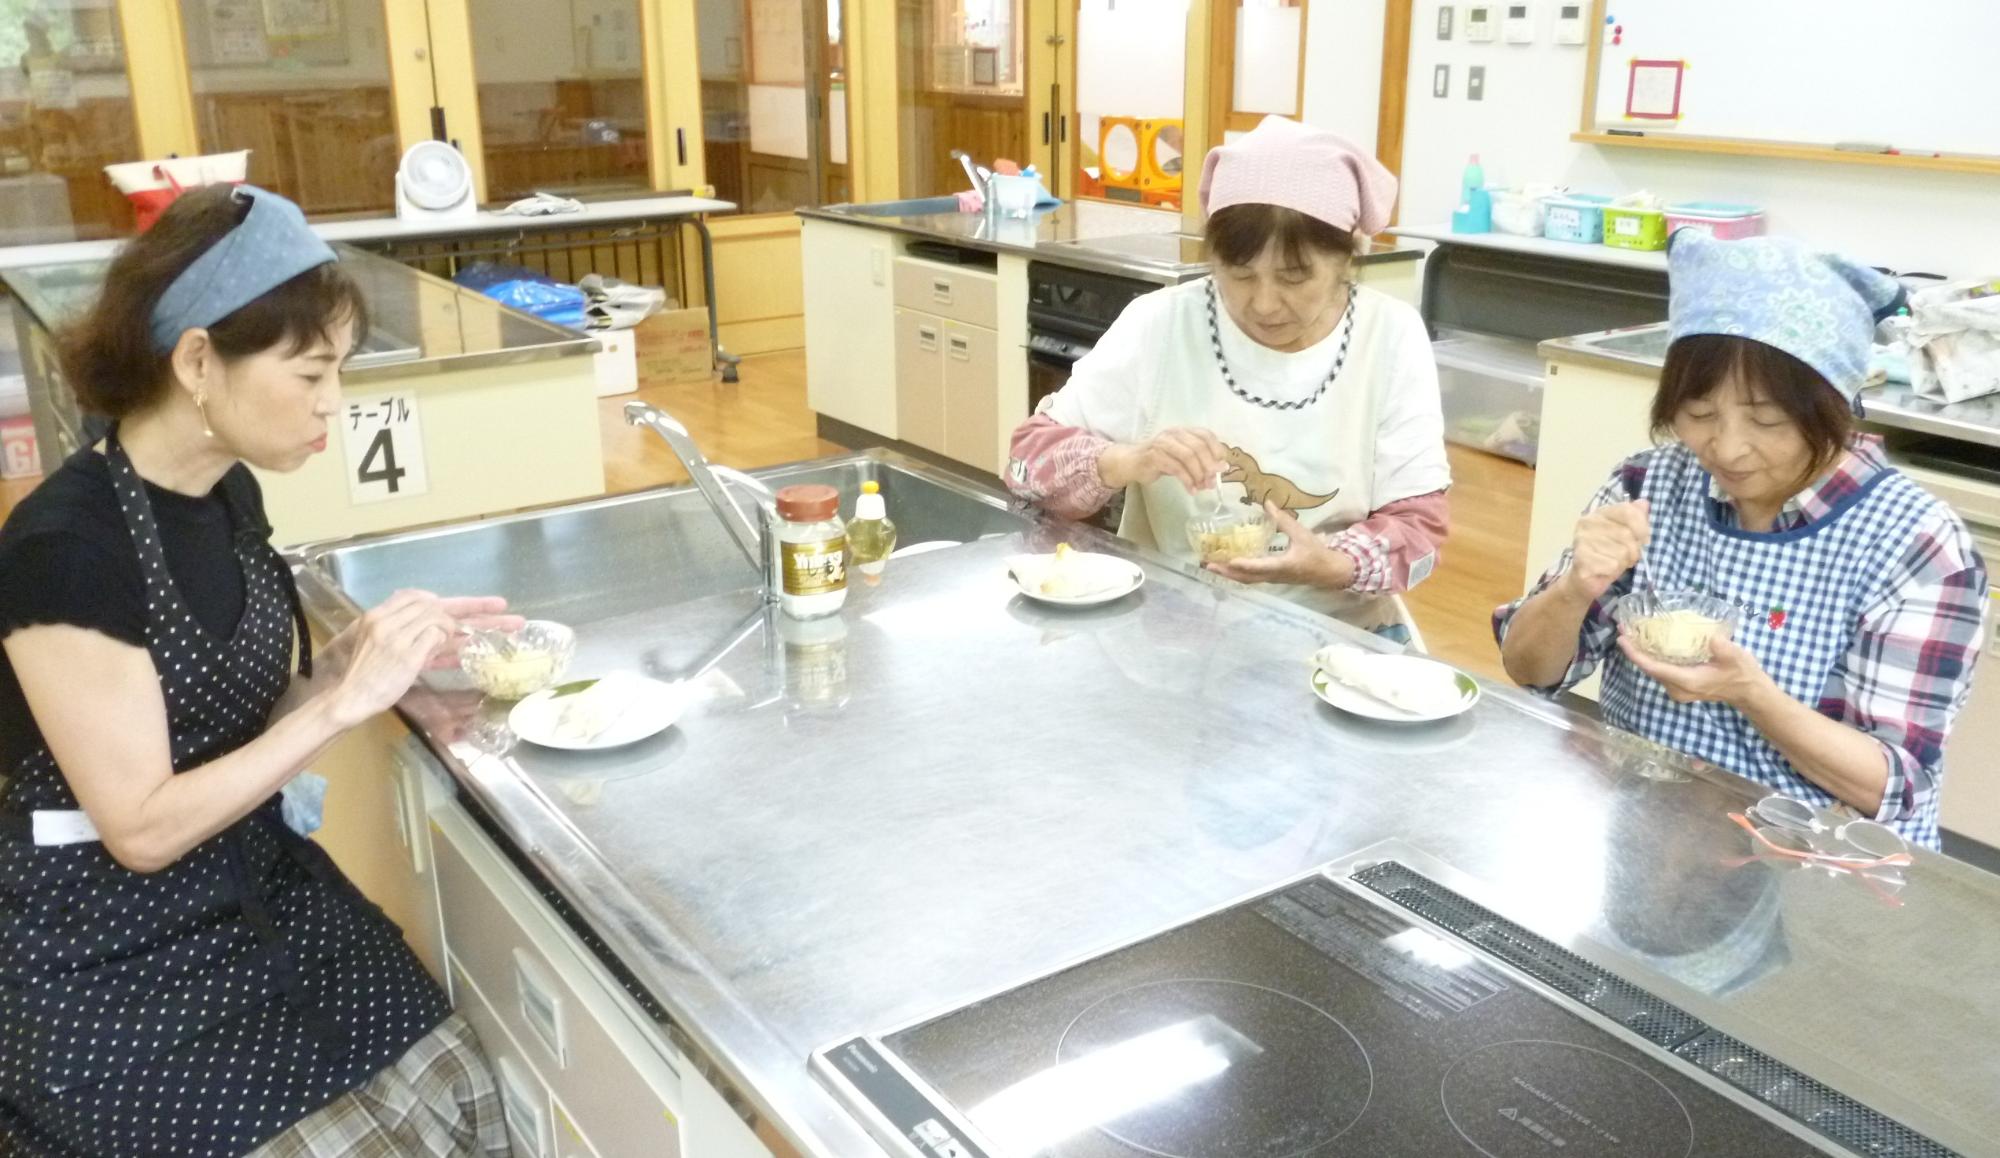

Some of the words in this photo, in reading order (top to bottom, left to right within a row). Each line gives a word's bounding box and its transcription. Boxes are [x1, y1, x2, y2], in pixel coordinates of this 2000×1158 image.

[350, 397, 409, 430] テーブル
[358, 428, 405, 493] 4
